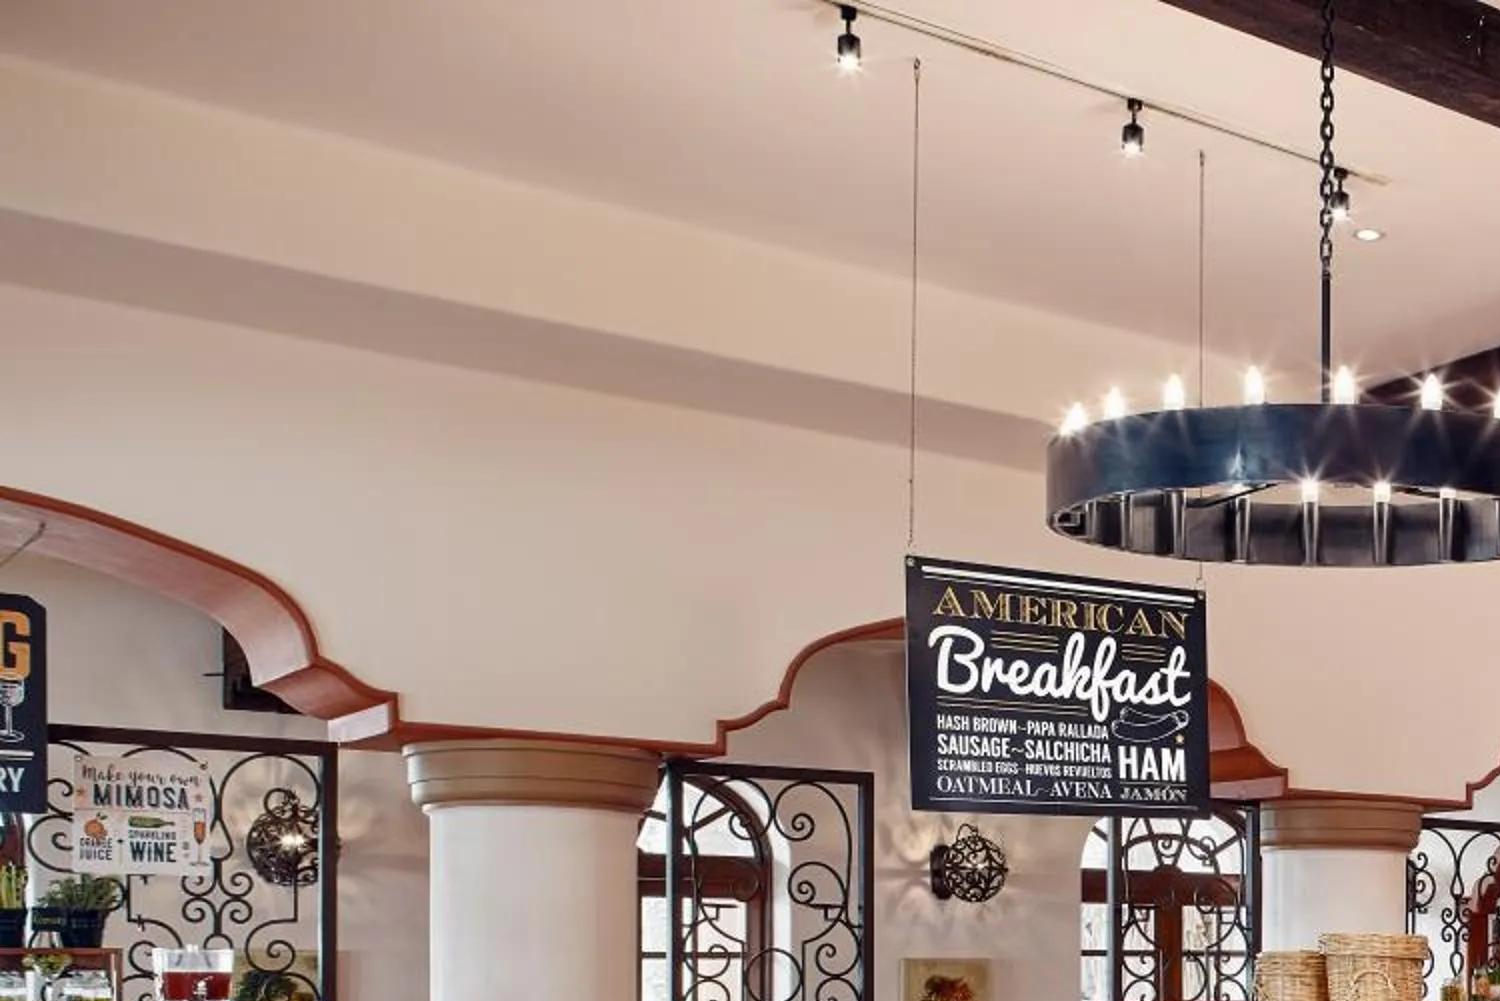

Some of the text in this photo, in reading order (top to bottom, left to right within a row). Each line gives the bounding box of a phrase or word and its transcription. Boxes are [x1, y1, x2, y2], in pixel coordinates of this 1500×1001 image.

[931, 584, 1190, 640] AMERICAN
[927, 625, 1192, 722] Breakfast
[937, 714, 1109, 740] HASH BROWN PAPA RALLADA
[937, 733, 1112, 763] SAUSAGE SALCHICHA
[1118, 745, 1187, 782] HAM
[93, 783, 190, 810] MIMOSA
[937, 775, 1113, 799] OATMEAL AVENA
